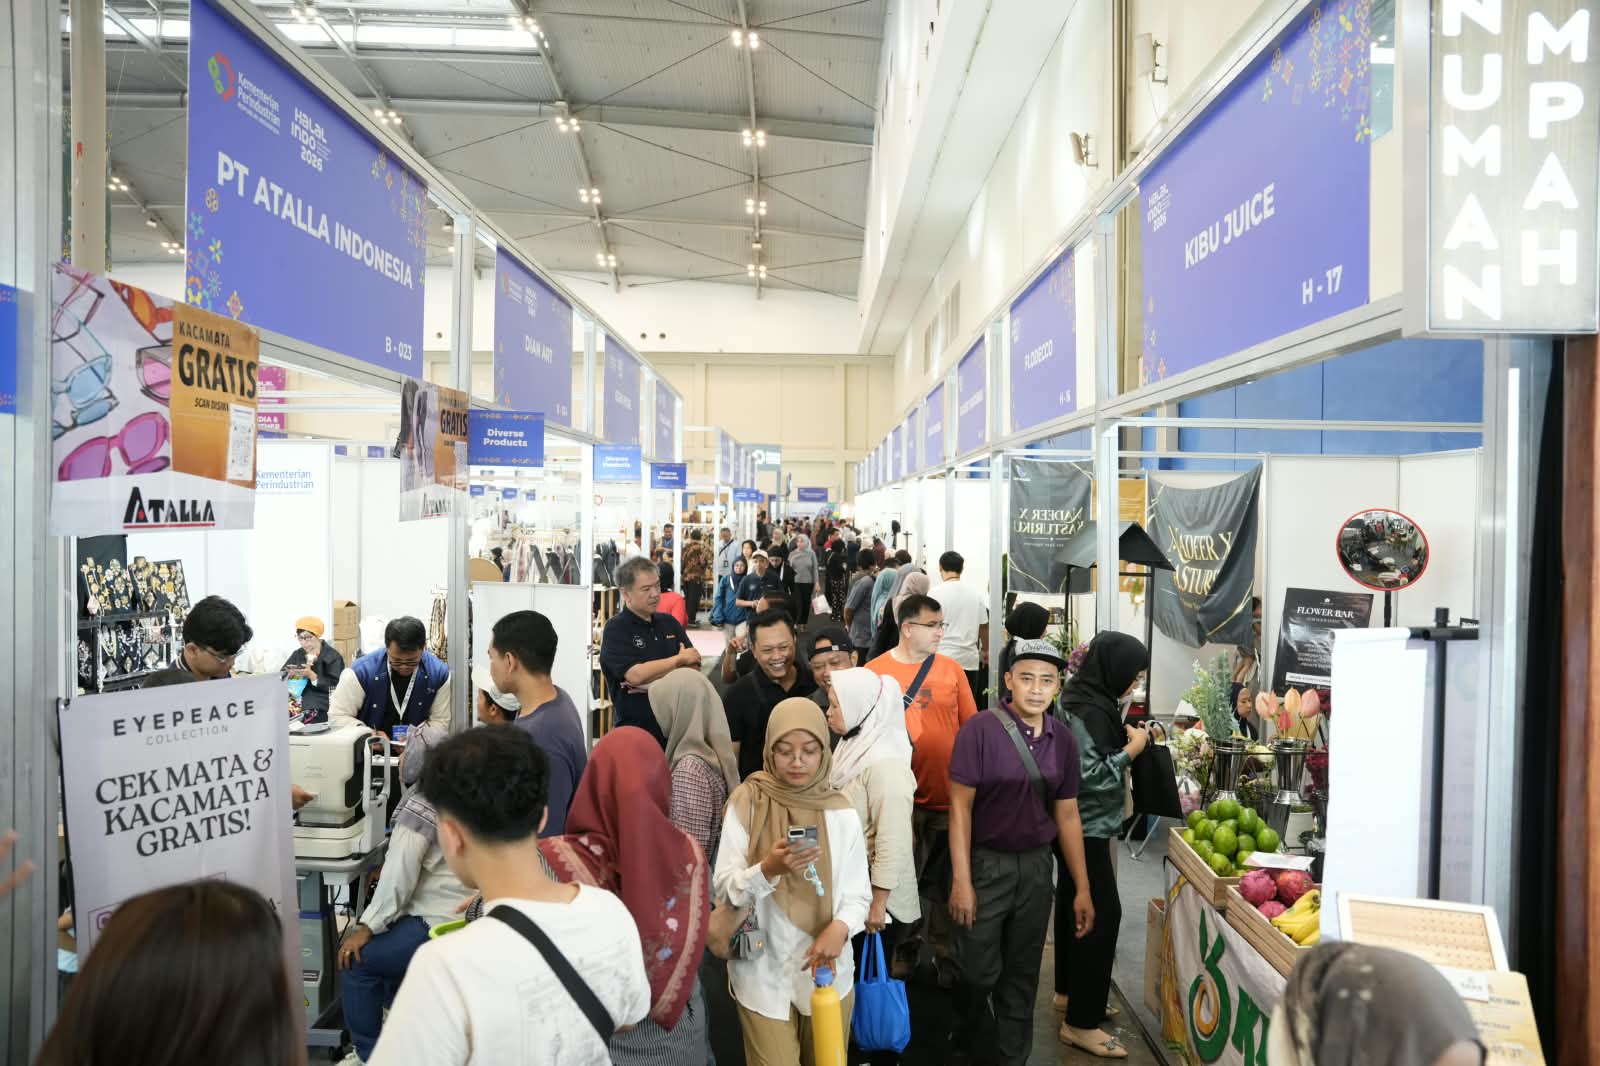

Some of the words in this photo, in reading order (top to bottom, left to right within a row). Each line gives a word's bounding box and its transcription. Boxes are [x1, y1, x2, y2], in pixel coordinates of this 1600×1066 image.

[301, 145, 323, 172] 2026
[218, 151, 249, 197] PT
[253, 175, 330, 245] ATALLA
[335, 221, 414, 289] INDONESIA
[1185, 221, 1220, 269] KIBU
[1223, 182, 1276, 245] JUICE
[1302, 278, 1313, 305] H
[1326, 264, 1343, 295] 17
[179, 320, 230, 349] KACAMATA
[385, 335, 392, 353] B
[398, 341, 412, 361] 023
[178, 343, 257, 399] GRATIS
[194, 397, 210, 409] SCAN
[440, 408, 468, 437] GRATIS
[487, 428, 524, 438] Diverse
[483, 437, 528, 448] Products
[123, 486, 216, 523] ATALLA
[1296, 606, 1333, 618] FLOWER
[1334, 609, 1354, 619] BAR
[112, 700, 256, 737] EYEPEACE
[145, 725, 230, 747] COLLECTION
[95, 769, 162, 805] CEK
[165, 753, 249, 792] MATA
[253, 748, 273, 772] &
[103, 776, 271, 836] KACAMATA
[135, 807, 252, 857] GRATIS!
